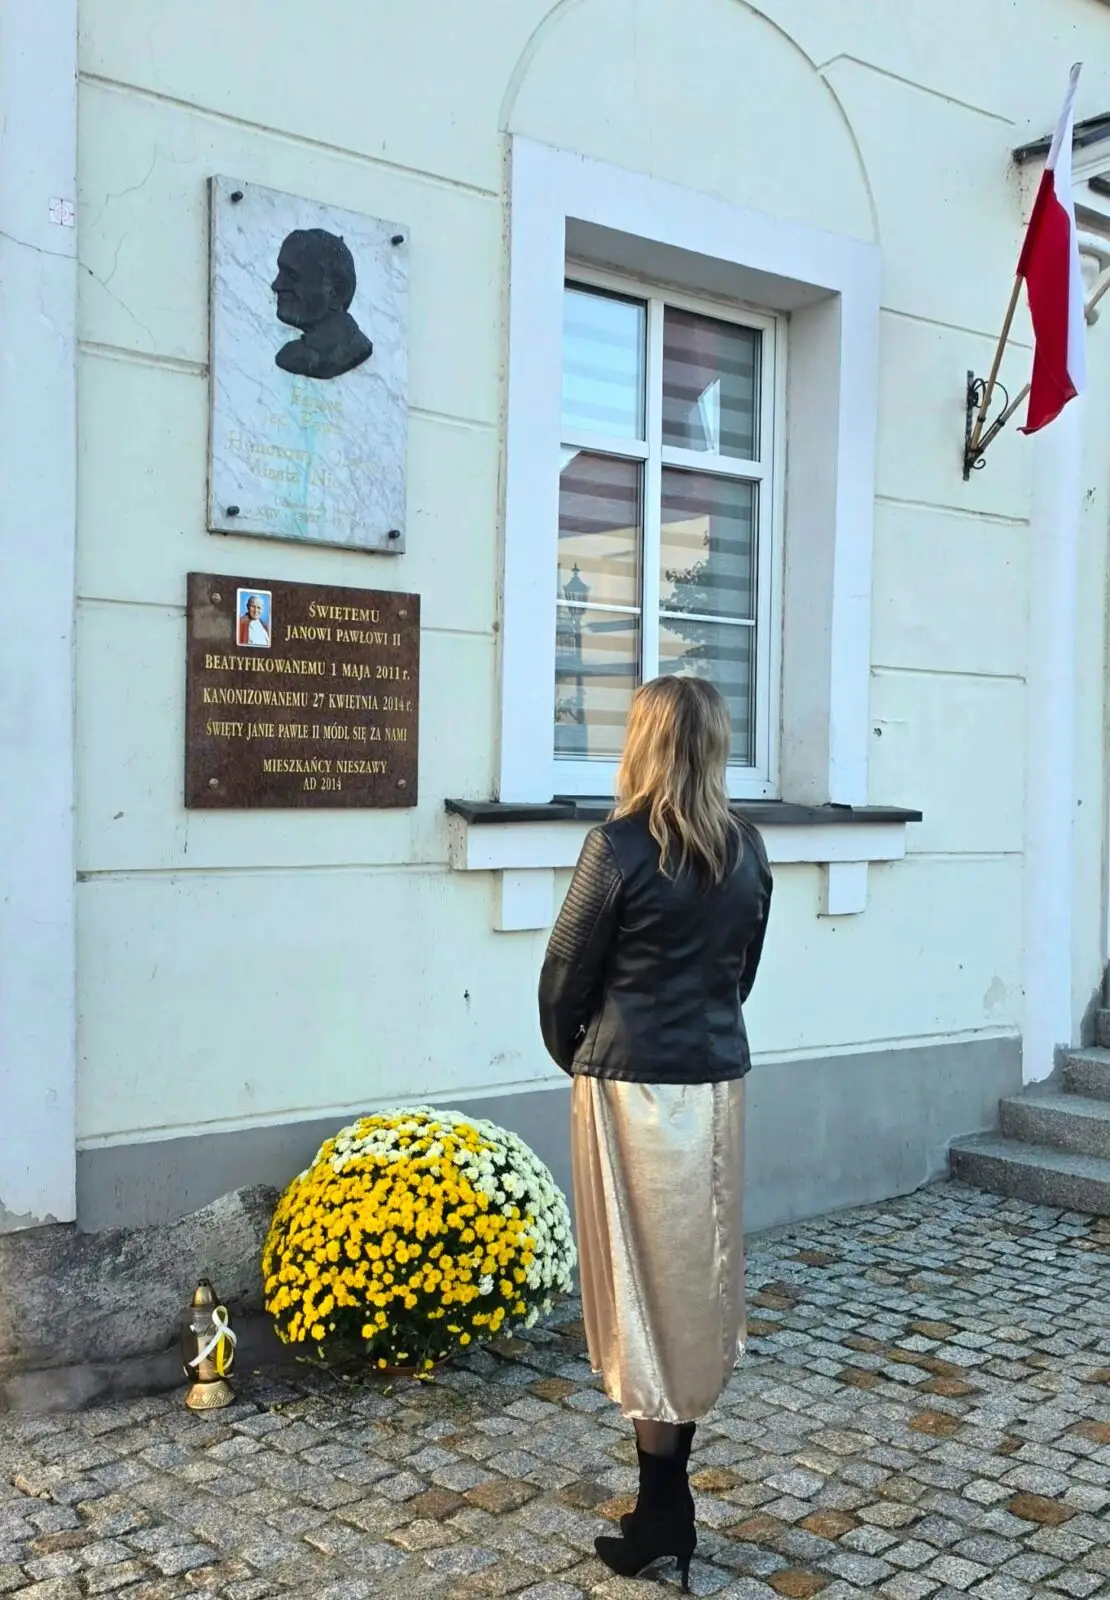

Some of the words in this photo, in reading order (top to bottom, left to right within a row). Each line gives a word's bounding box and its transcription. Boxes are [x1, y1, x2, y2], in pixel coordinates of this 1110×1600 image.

[309, 601, 380, 623] ŚWIĘTEMU
[285, 625, 331, 642] JANOWI
[336, 629, 388, 645] PAWŁOWI
[392, 633, 401, 646] II
[205, 654, 325, 676] BEATYFIKOWANEMU
[331, 663, 337, 676] 1
[342, 665, 370, 681] MAJA
[376, 665, 400, 680] 2011
[203, 687, 308, 707] KANONIZOWANEMU
[313, 693, 324, 708] 27
[329, 694, 378, 710] KWIETNIA
[383, 696, 404, 711] 2014
[206, 717, 243, 739] ŚWIĘTY
[246, 723, 274, 740] JANIE
[312, 725, 319, 739] II
[324, 722, 349, 740] MÓDL
[353, 726, 366, 743] SIĘ
[370, 727, 381, 740] ZA
[385, 727, 407, 742] NAMI
[263, 756, 332, 773] MIESZKAŃCY
[336, 760, 388, 773] NIESZAWY
[303, 777, 316, 790] AD
[321, 777, 342, 791] 2014
